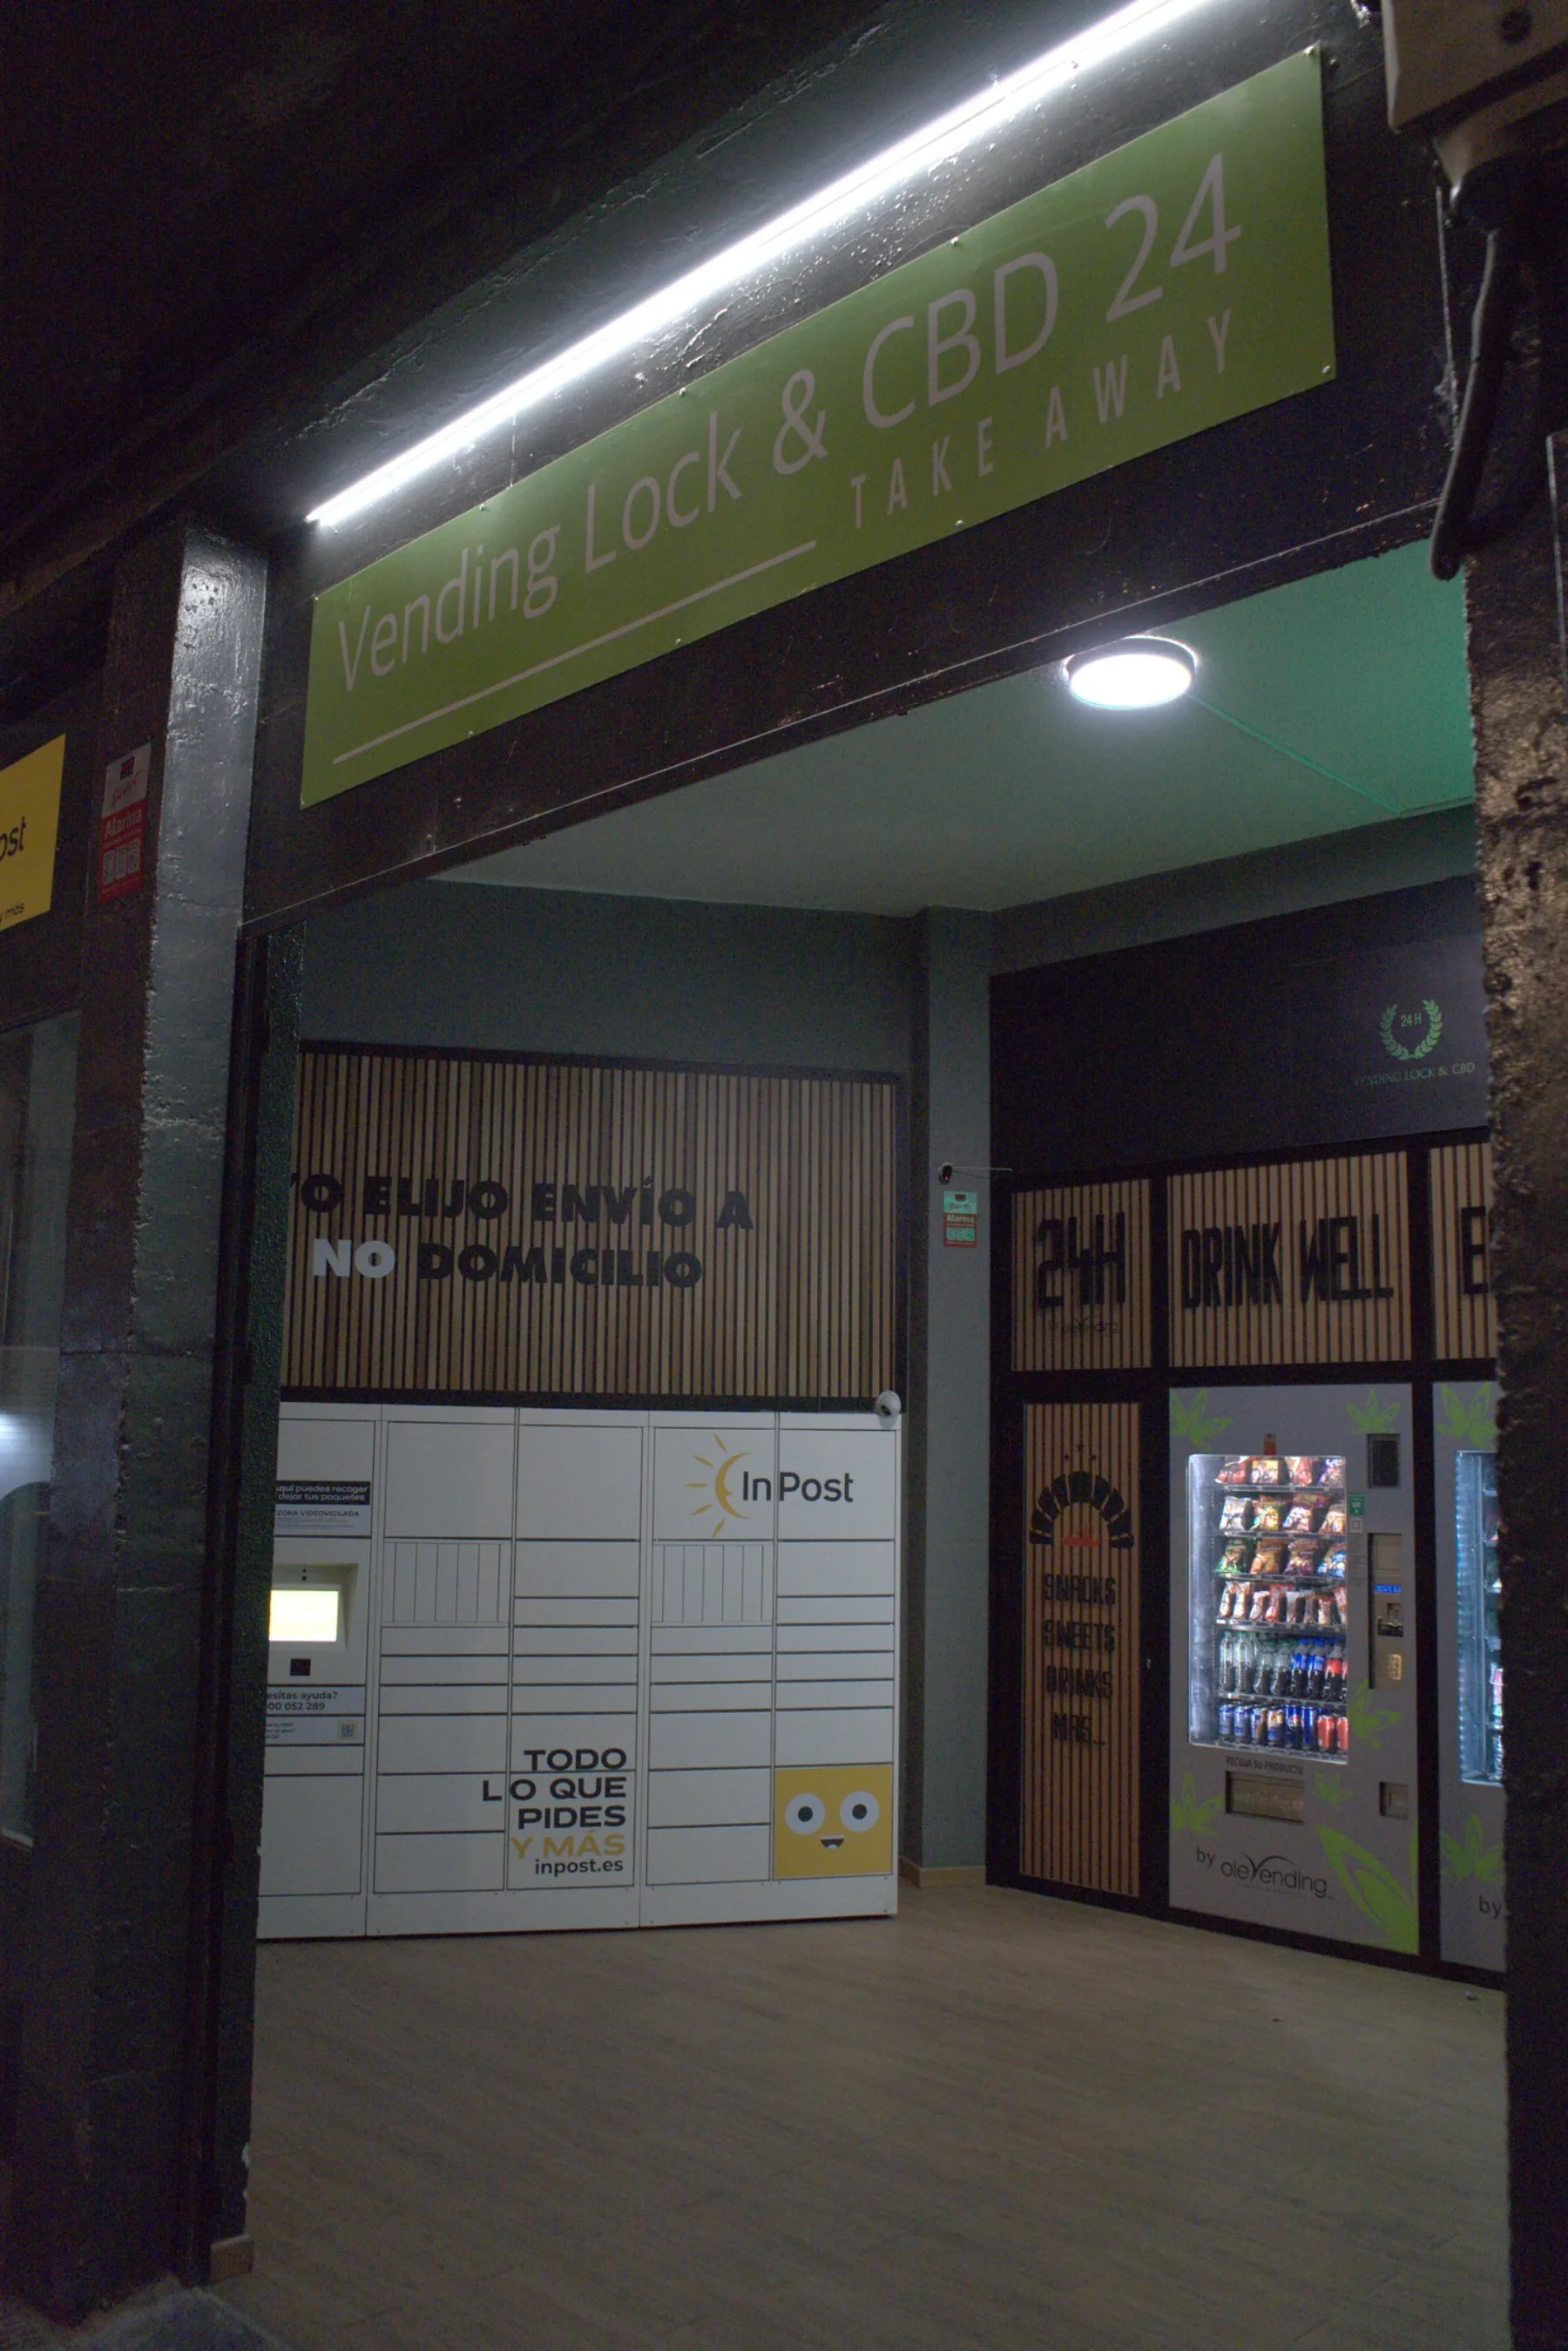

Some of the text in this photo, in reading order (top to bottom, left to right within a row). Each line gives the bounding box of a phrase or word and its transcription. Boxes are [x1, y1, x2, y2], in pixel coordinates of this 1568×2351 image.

[337, 152, 1241, 692] Vending Lock & CBD 24
[851, 308, 1234, 528] TAKE AWAY
[1400, 1012, 1423, 1027] 24 H
[1404, 1067, 1436, 1081] LOCK
[1438, 1066, 1449, 1077] &
[1451, 1061, 1476, 1074] CBD
[291, 1172, 754, 1230] O ELIJO ENVÍO A
[313, 1237, 702, 1290] NO DOMICILIO
[1038, 1211, 1126, 1307] 24H
[1181, 1213, 1396, 1308] DRINK WELL
[275, 1484, 368, 1495] quí puedes recoger
[279, 1492, 303, 1501] dejar
[321, 1494, 366, 1503] paquetes
[742, 1471, 854, 1504] InPost
[1044, 1573, 1116, 1607] SNACKS
[1044, 1619, 1116, 1653] SWEETS
[1046, 1664, 1113, 1699] DRINKS
[285, 1702, 304, 1711] 052
[300, 1691, 339, 1702] ayuda?
[524, 1748, 626, 1772] TODO
[1226, 1755, 1304, 1776] RECOJA SU PRODUCTO
[483, 1776, 627, 1801] LO QUE
[517, 1805, 627, 1831] PIDES
[510, 1830, 626, 1859] Y MÁS
[1197, 1846, 1215, 1867] by
[535, 1857, 624, 1876] inpost.es
[1479, 1895, 1503, 1920] by
